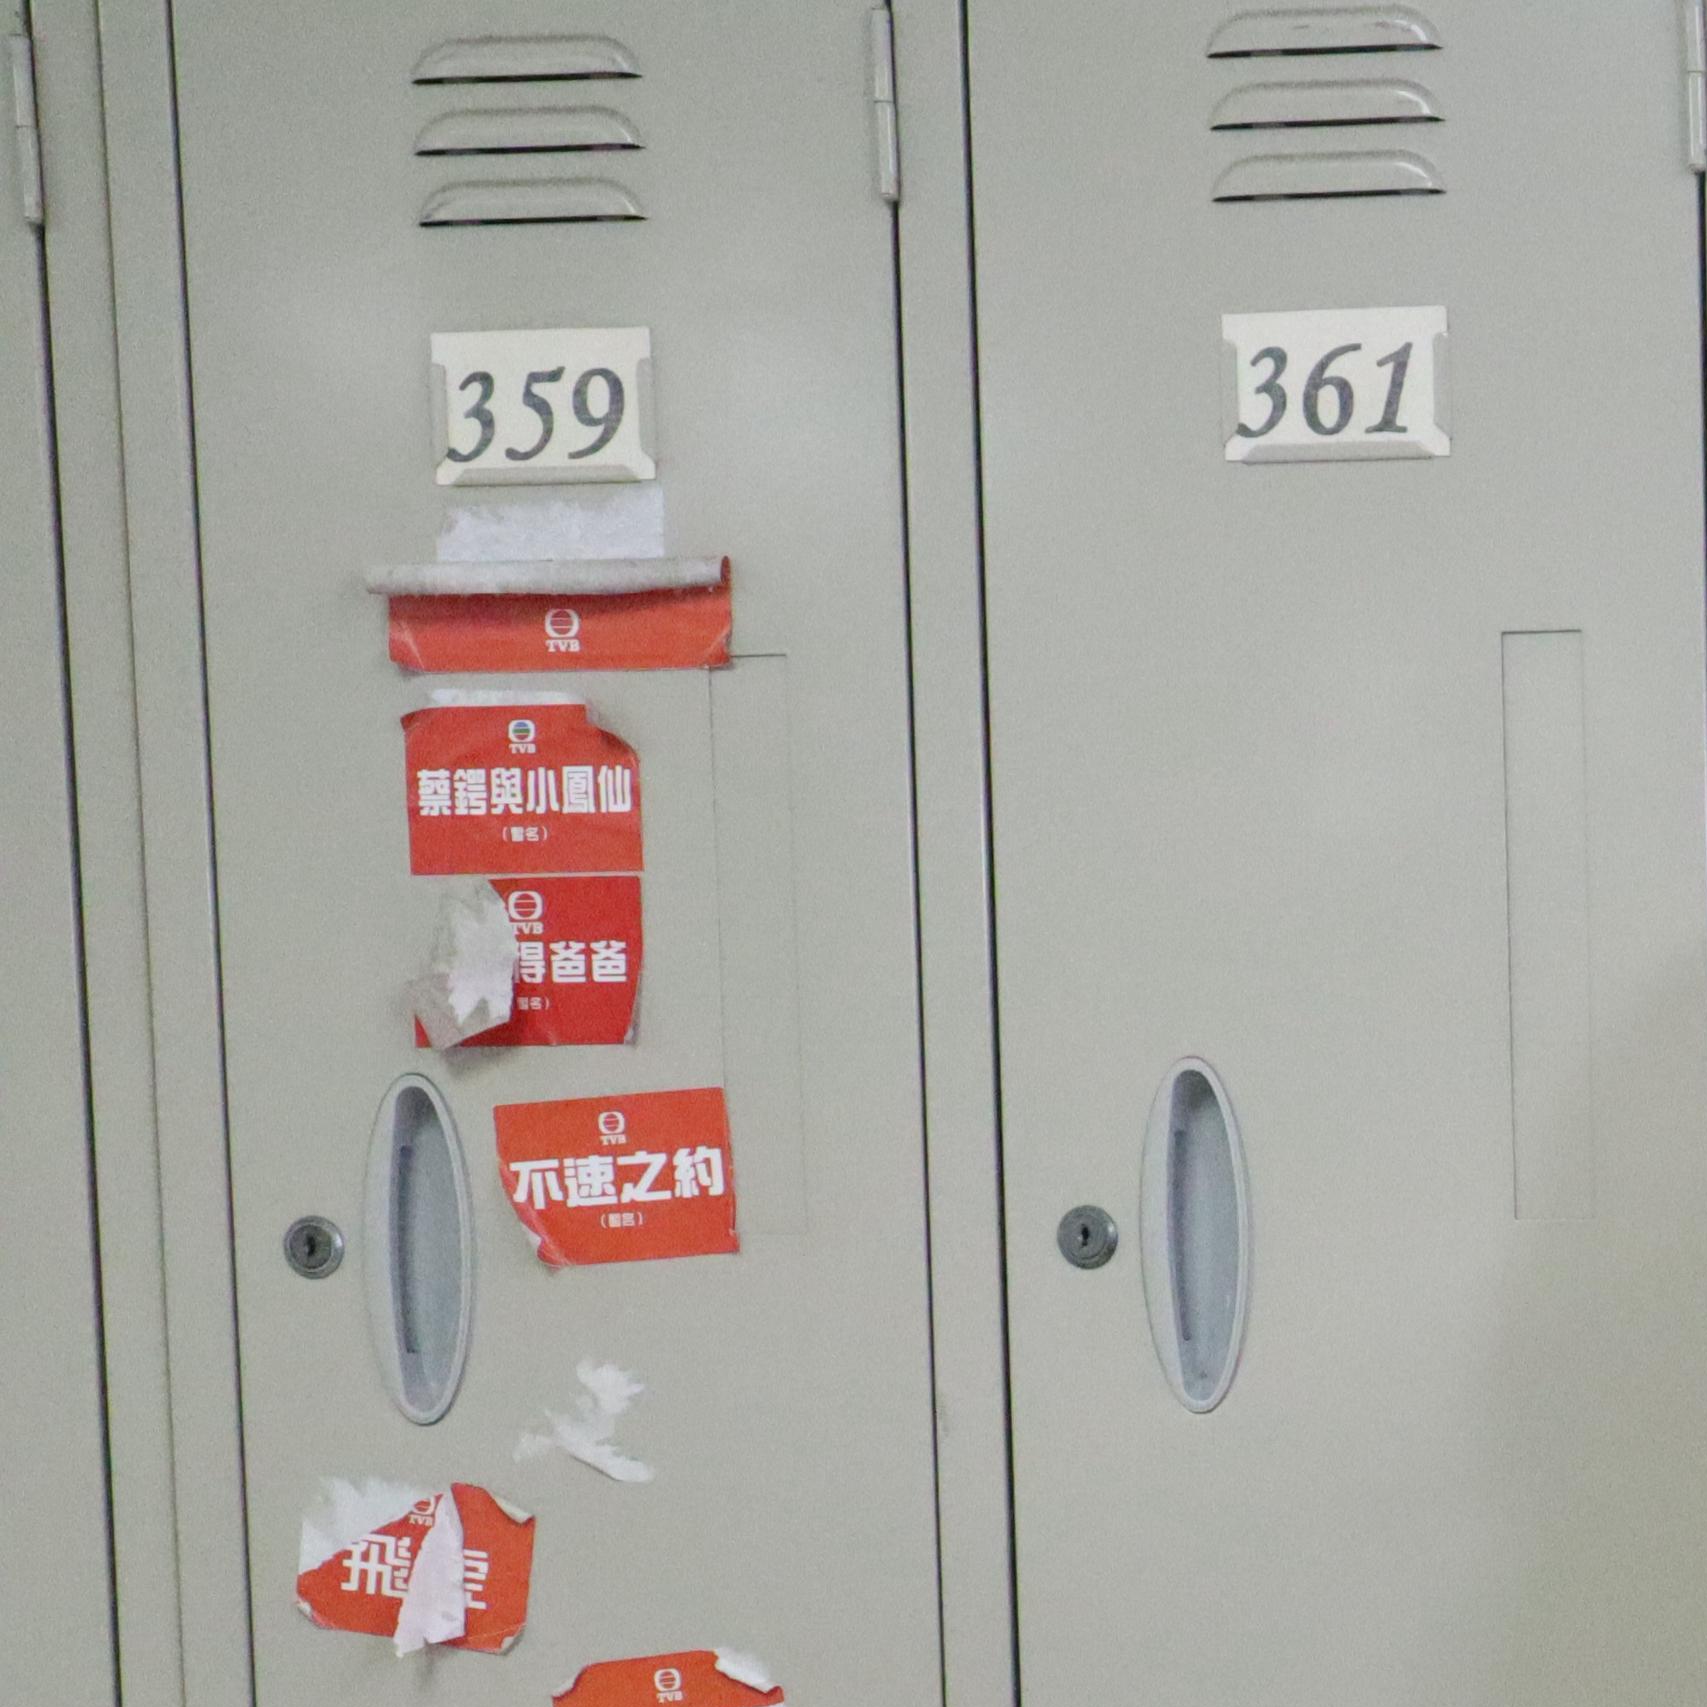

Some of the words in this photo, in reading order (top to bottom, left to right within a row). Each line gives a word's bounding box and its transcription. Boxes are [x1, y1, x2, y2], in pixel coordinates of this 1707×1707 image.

[1236, 342, 1413, 438] 361
[447, 366, 625, 463] 359
[546, 640, 581, 653] TVB
[509, 743, 536, 754] TVB
[601, 1135, 626, 1146] TVB
[510, 1146, 725, 1210] 不速之約
[657, 1691, 683, 1703] TVB
